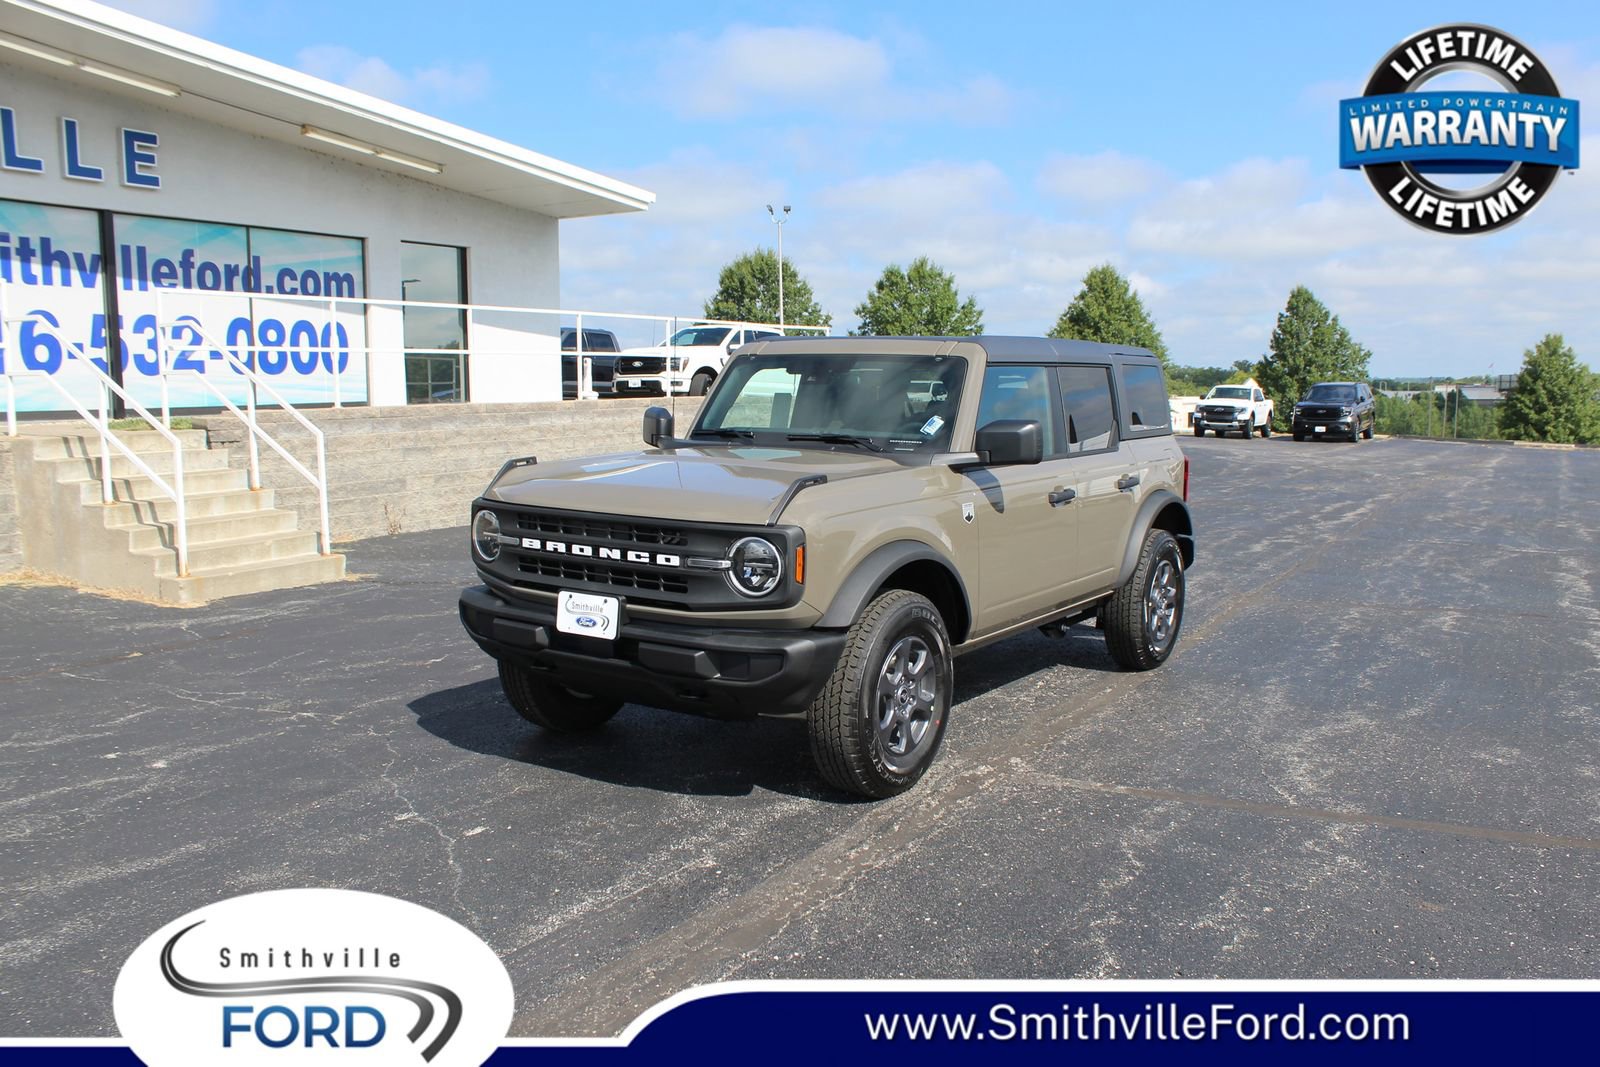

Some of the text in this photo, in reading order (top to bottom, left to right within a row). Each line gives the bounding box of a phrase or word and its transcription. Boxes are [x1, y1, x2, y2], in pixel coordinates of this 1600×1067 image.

[0, 231, 356, 299] ithvlleford.com
[0, 309, 349, 377] 6-532-0800
[522, 538, 680, 567] BRONCO
